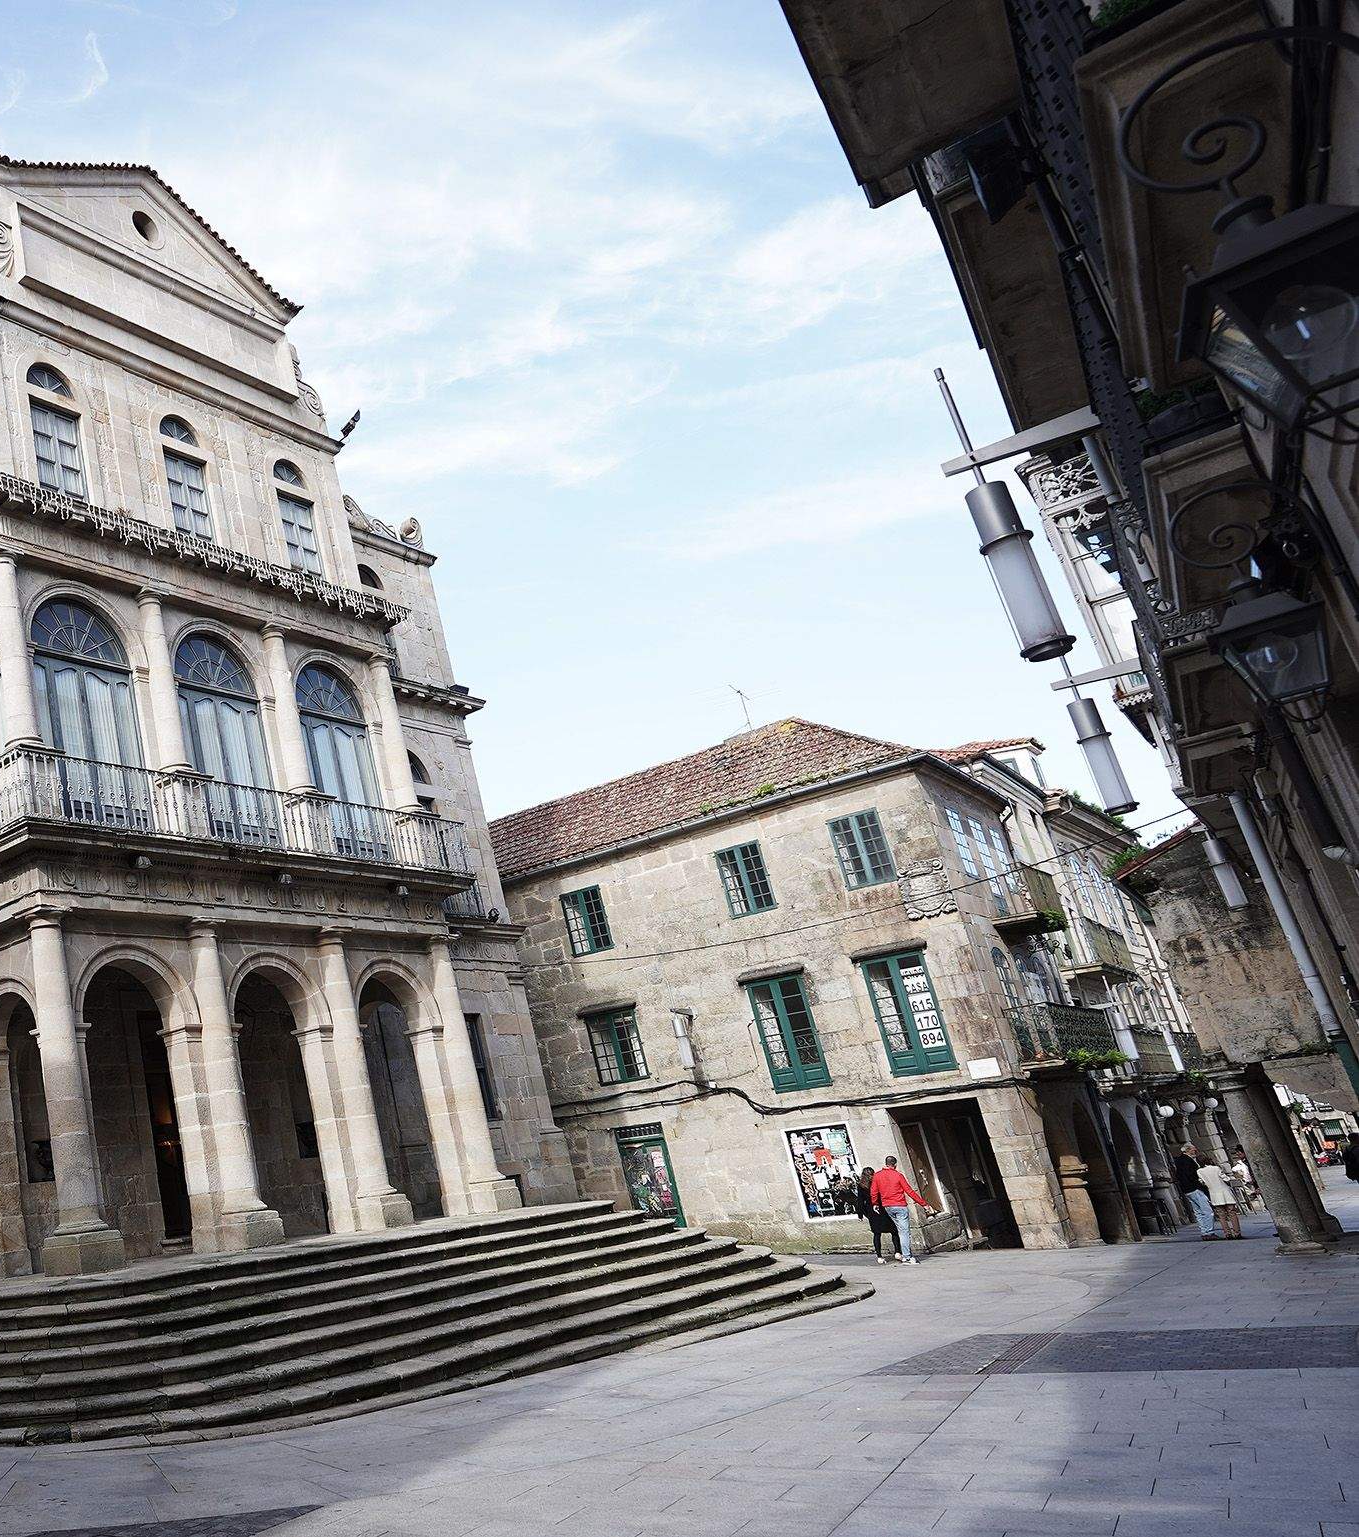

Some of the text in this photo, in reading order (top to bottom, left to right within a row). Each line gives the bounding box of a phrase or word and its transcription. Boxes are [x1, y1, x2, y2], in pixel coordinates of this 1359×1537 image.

[904, 981, 929, 994] CASA
[911, 999, 934, 1012] 615
[917, 1014, 939, 1029] 170
[921, 1031, 944, 1046] 894
